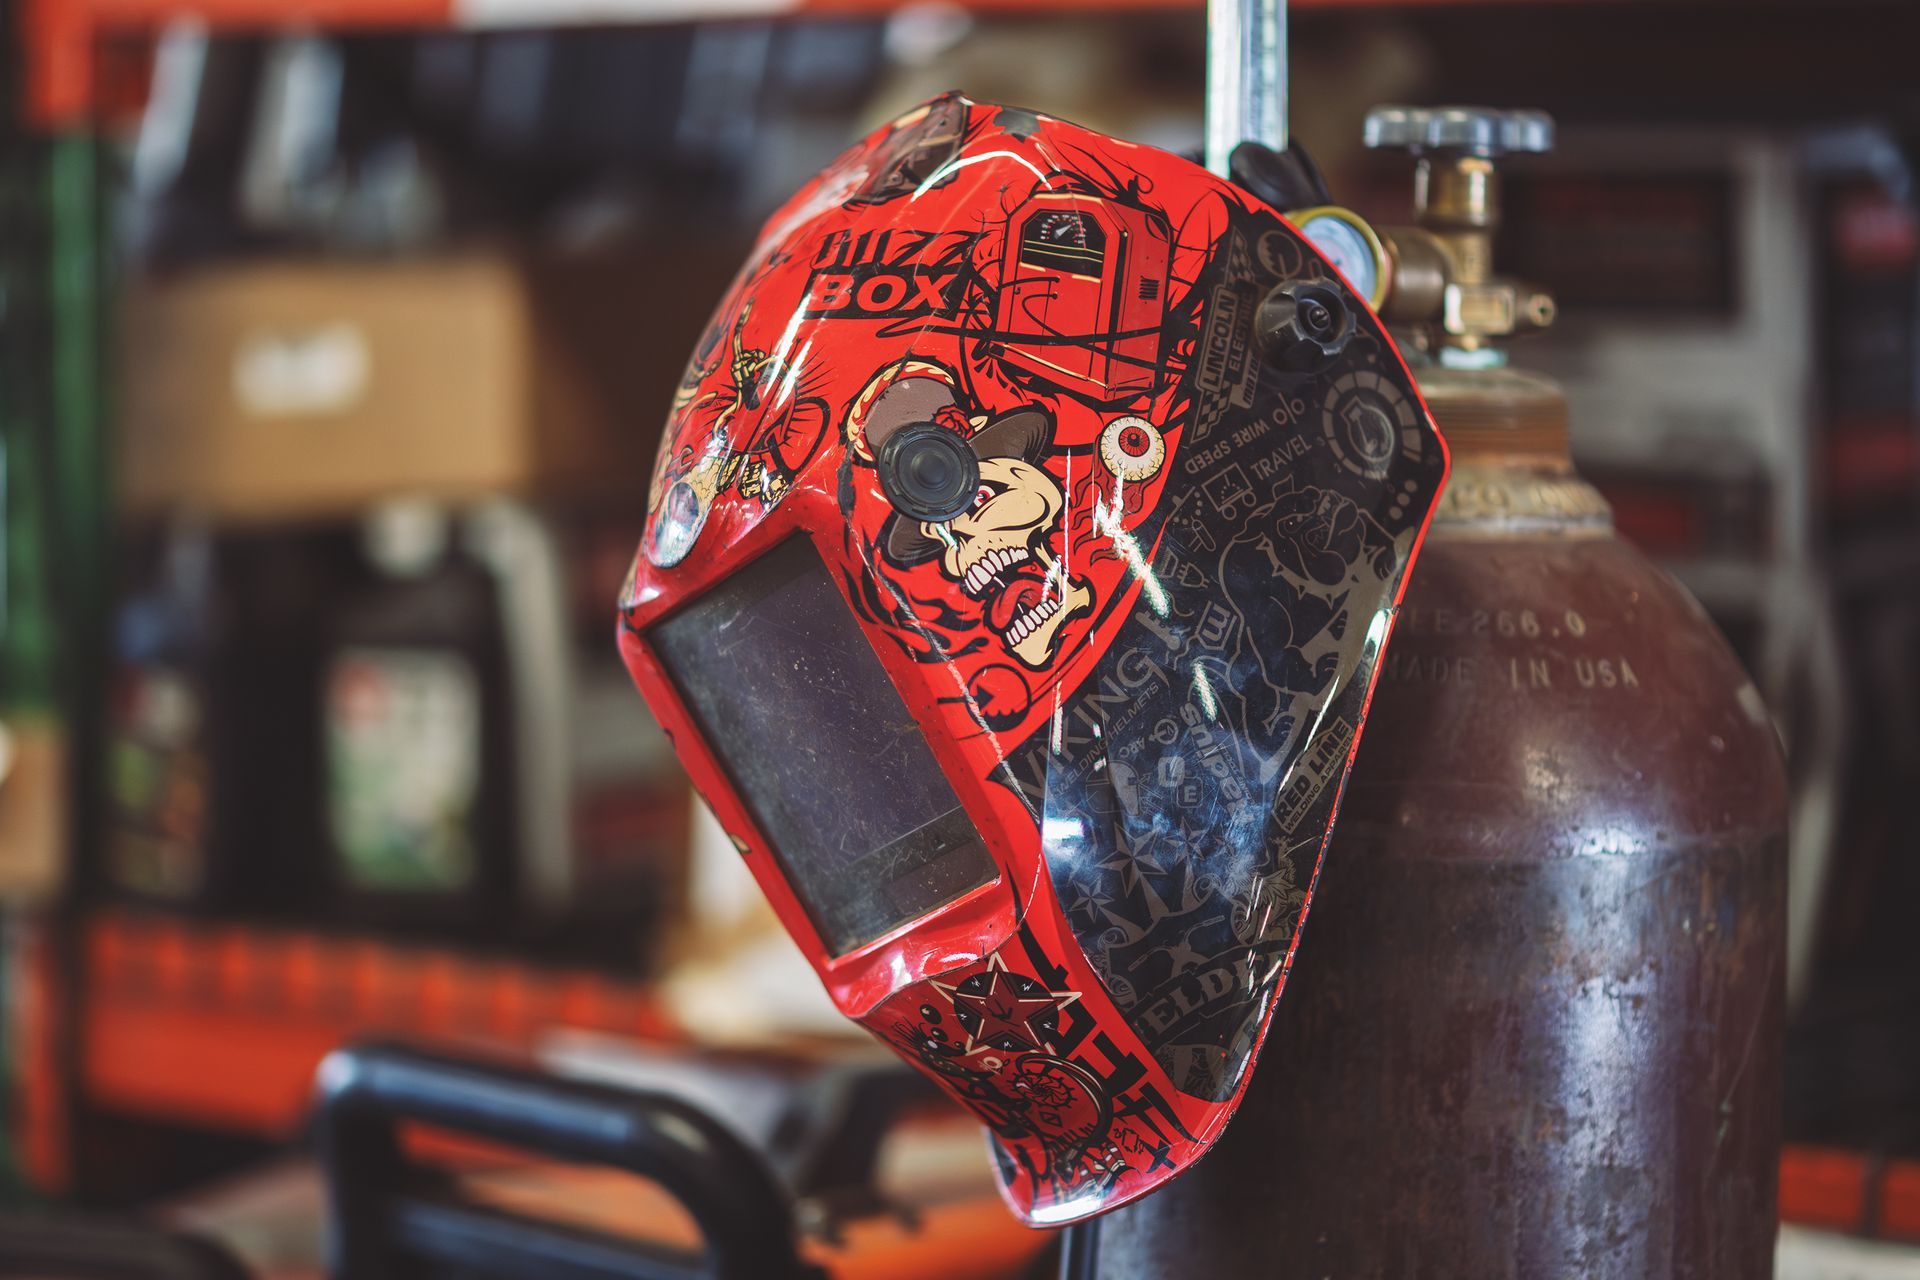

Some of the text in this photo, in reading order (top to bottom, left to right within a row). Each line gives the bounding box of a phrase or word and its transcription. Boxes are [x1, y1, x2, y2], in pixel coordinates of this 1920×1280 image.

[806, 273, 960, 312] BOX
[1203, 293, 1236, 386] LINCOLN
[1184, 418, 1270, 475] WIRE SPEED
[1250, 434, 1313, 481] TRAVEL
[1510, 655, 1550, 692] IN
[1575, 655, 1639, 689] USA
[1005, 647, 1169, 801] VIKING
[1058, 681, 1159, 797] WELDING HELMETS
[1275, 720, 1350, 824] RED LINE
[1285, 734, 1353, 832] WELDING APPAREL
